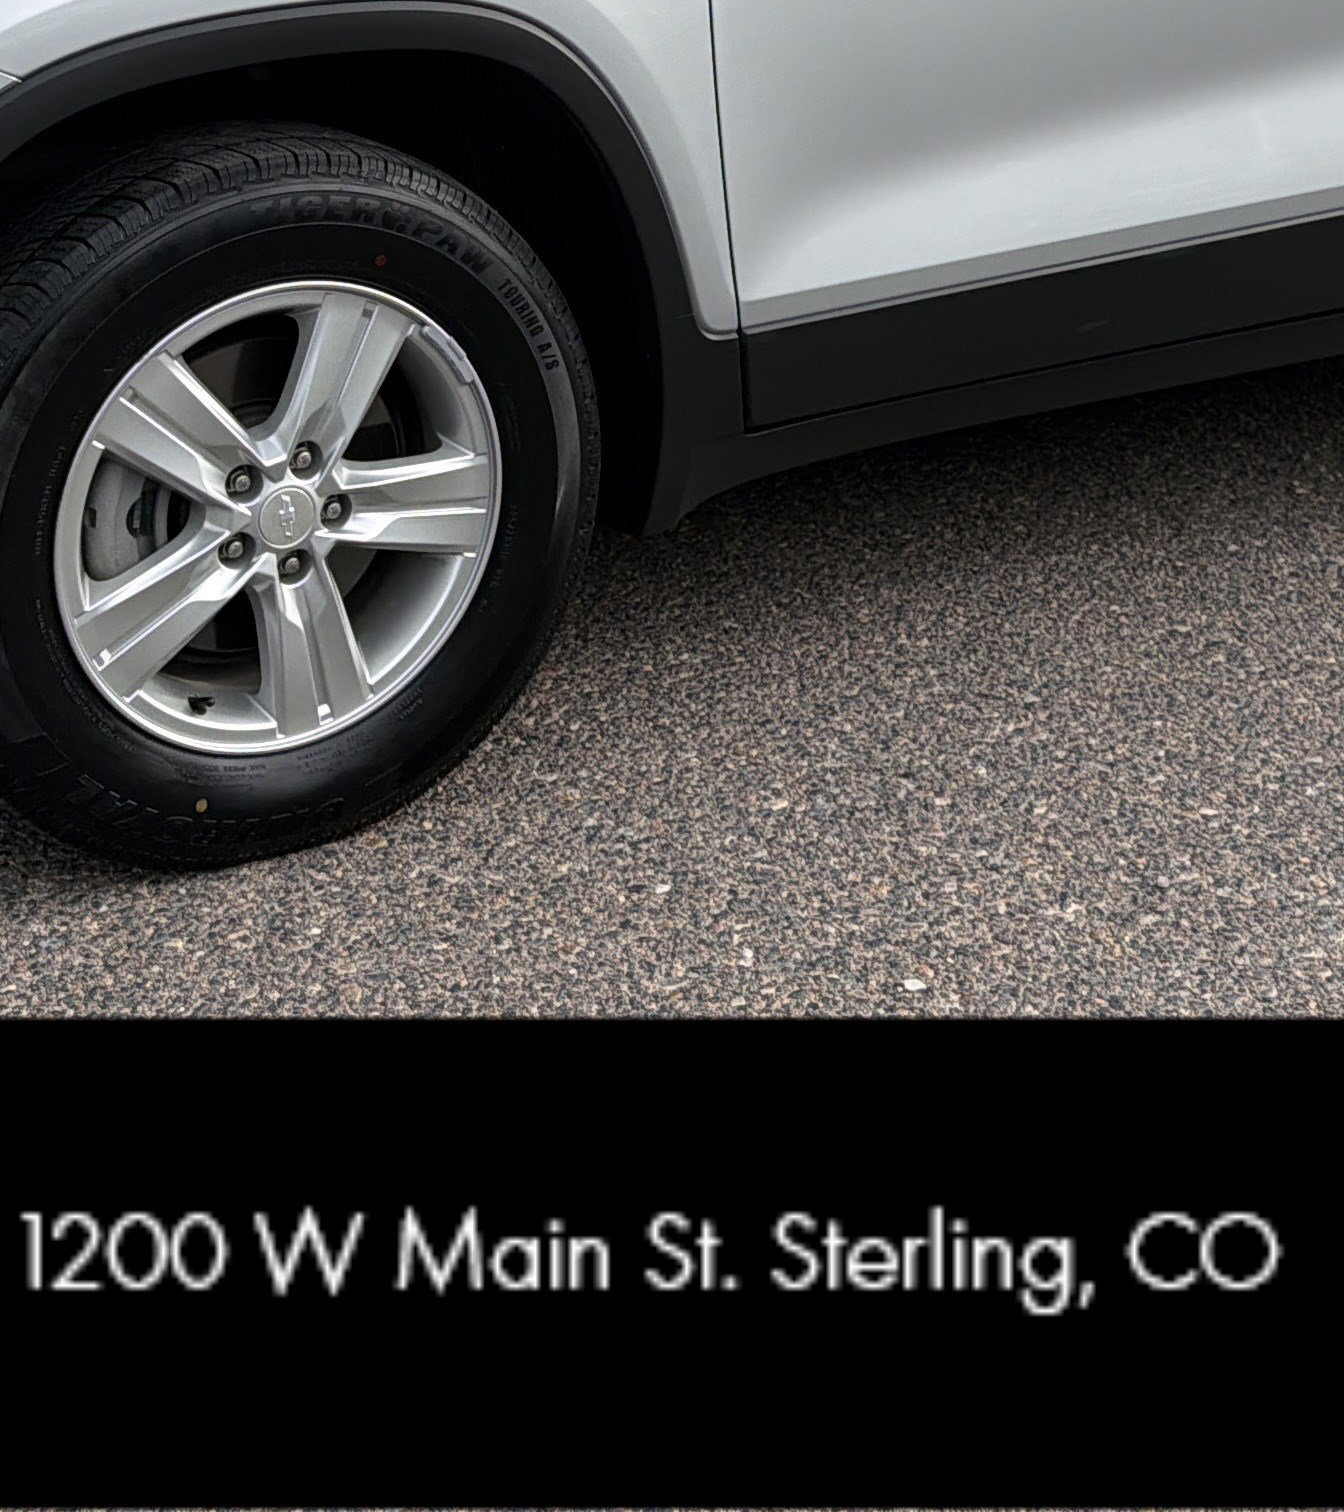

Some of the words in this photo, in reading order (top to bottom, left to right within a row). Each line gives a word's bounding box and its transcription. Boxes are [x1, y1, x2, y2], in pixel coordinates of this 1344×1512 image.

[251, 192, 381, 226] TIGER
[410, 217, 495, 275] PAW
[496, 278, 546, 338] TOURING
[536, 341, 562, 372] A/S
